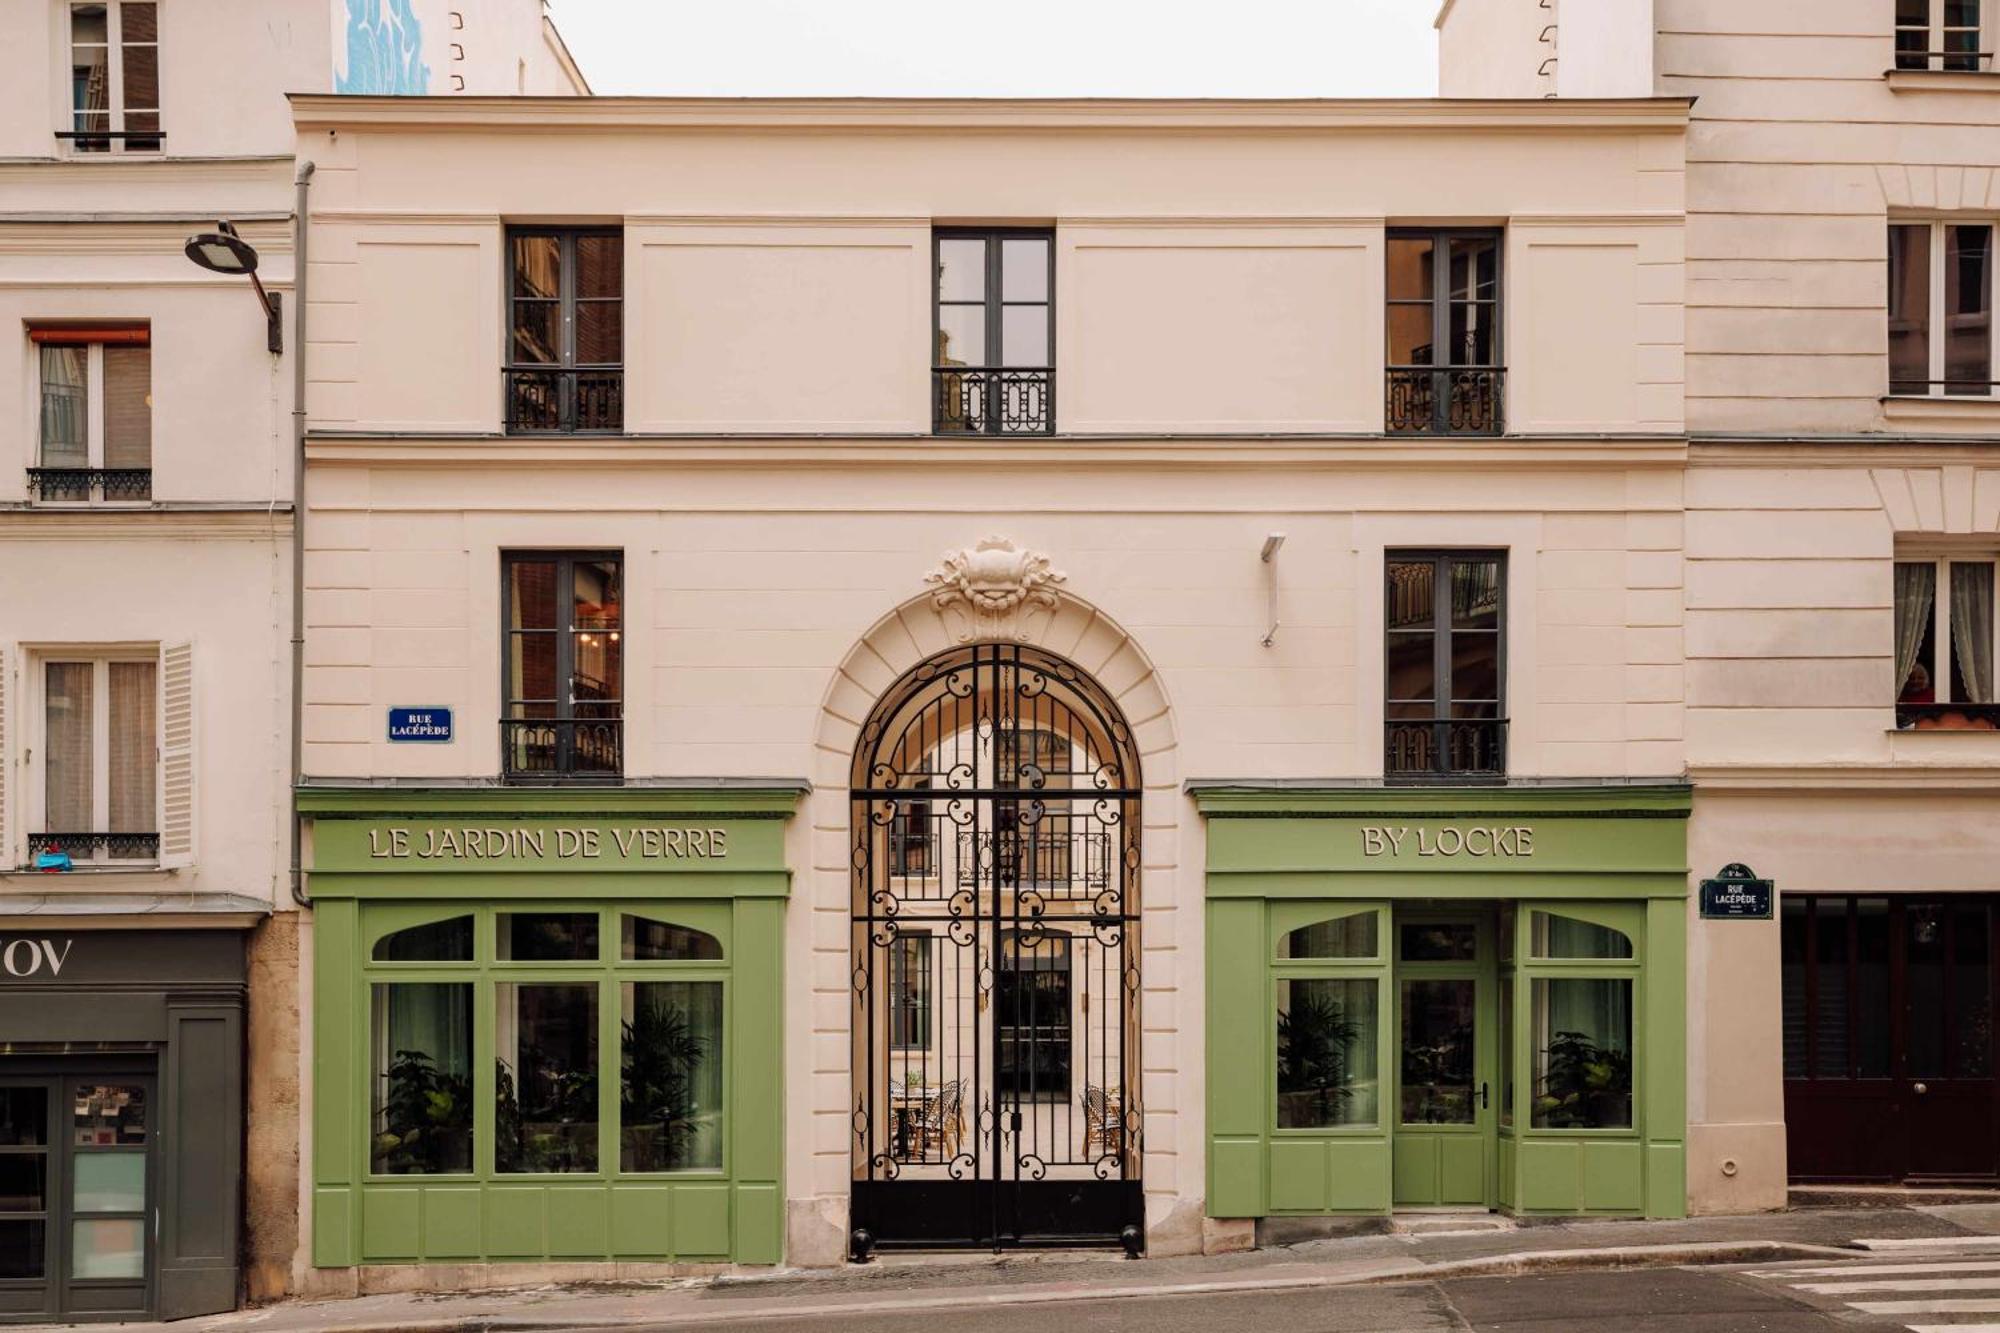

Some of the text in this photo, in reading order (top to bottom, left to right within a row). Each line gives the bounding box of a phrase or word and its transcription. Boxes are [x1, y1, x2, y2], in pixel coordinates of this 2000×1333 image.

[408, 714, 432, 724] RUE
[391, 723, 449, 736] LACÉPÈDE
[369, 828, 728, 859] LE JARDIN DE VERRE
[1361, 827, 1534, 857] BY LOCKE
[1727, 884, 1744, 894] RUE
